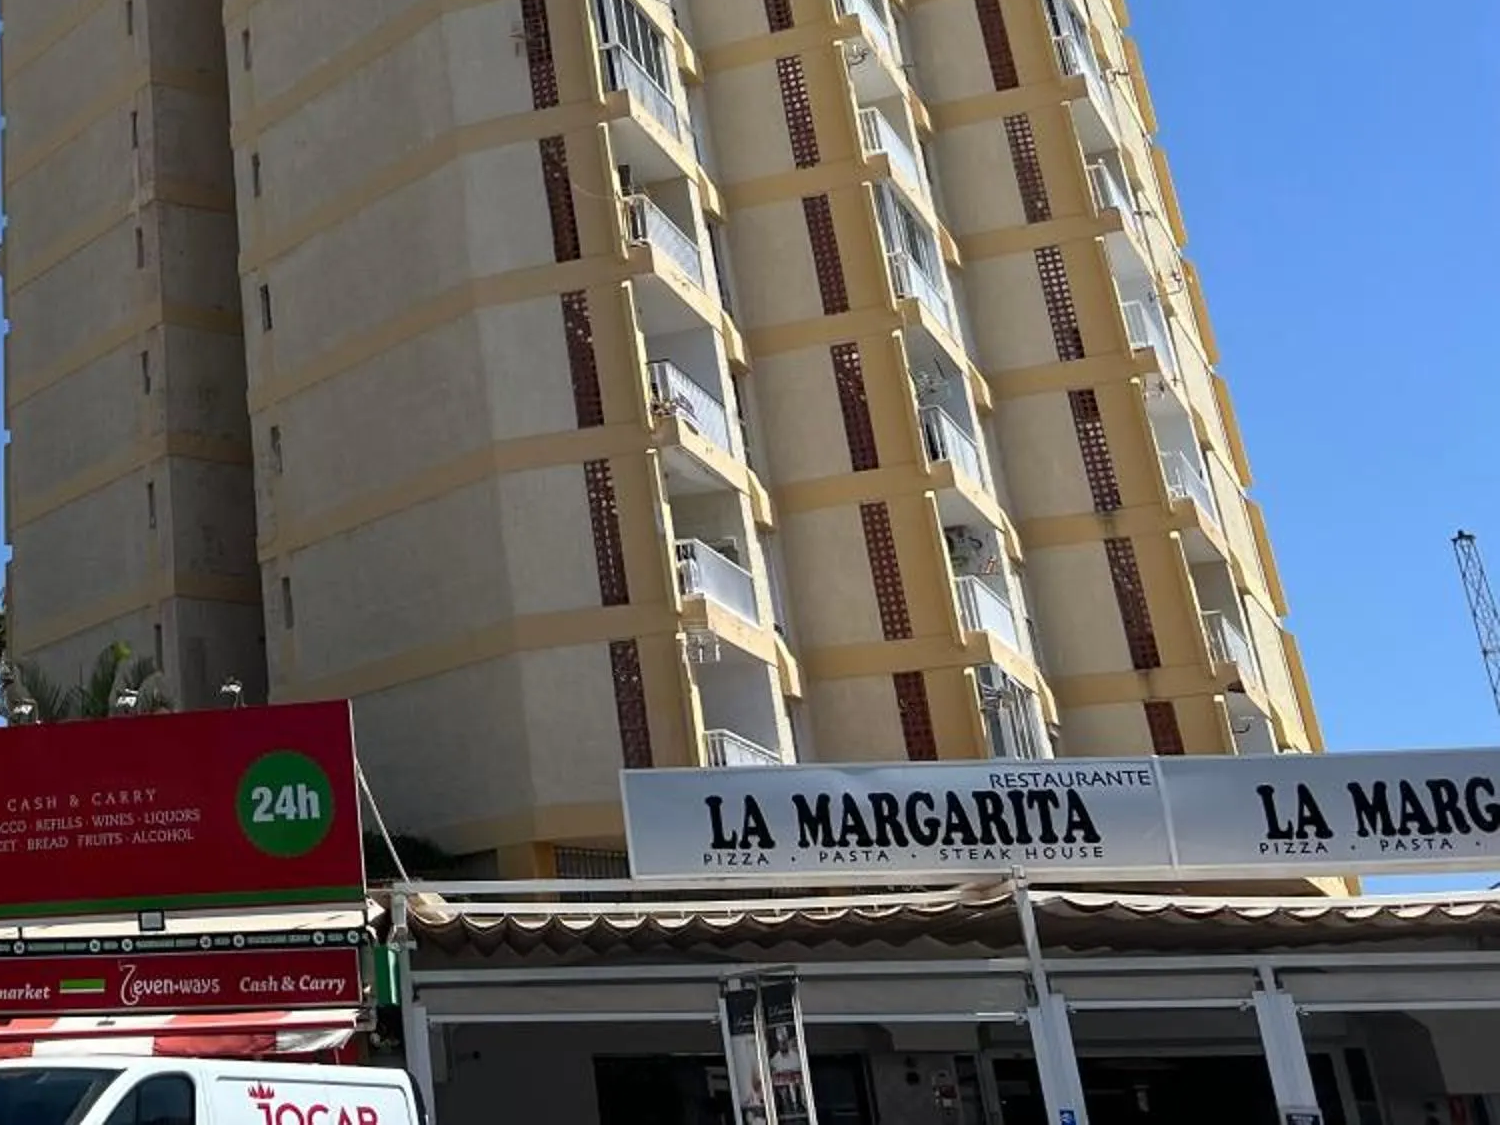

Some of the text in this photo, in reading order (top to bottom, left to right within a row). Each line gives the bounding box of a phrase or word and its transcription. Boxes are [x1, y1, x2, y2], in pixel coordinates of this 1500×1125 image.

[989, 770, 1151, 789] RESTAURANTE
[7, 788, 157, 812] CASH & CARRY
[251, 782, 321, 823] 24h
[1256, 776, 1500, 840] LA MARG
[36, 816, 83, 831] REFILLS
[91, 812, 135, 828] WINES
[144, 808, 201, 824] LIQUORS
[705, 788, 1102, 850] LA MARGARITA
[27, 835, 69, 851] BREAD
[77, 832, 123, 847] FRUITS
[132, 828, 195, 843] ALCOHOL
[1259, 838, 1453, 855] PIZZA PASTA
[703, 846, 1104, 866] PIZZA PASTA STEAK HOUSE
[239, 976, 278, 993] Cash
[281, 977, 295, 992] &
[299, 974, 346, 996] Carry
